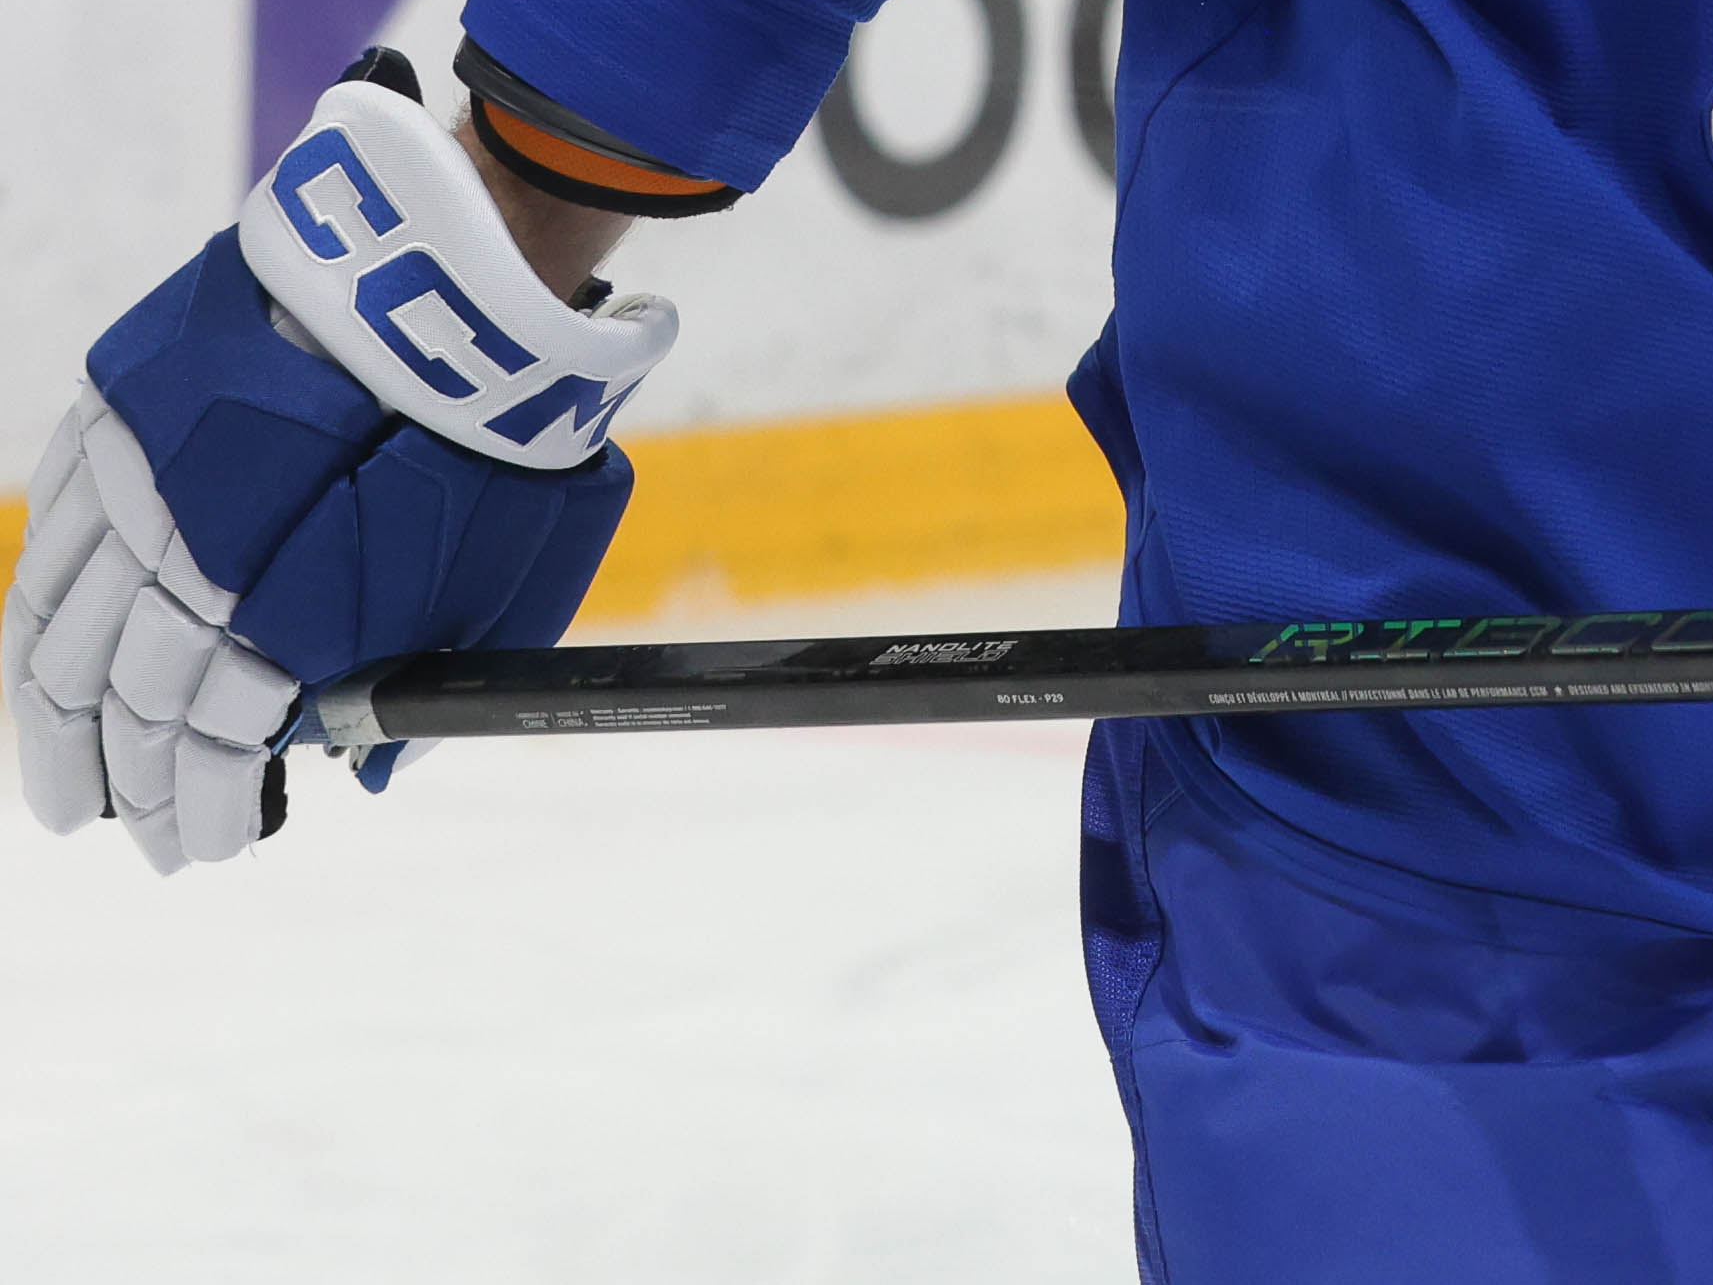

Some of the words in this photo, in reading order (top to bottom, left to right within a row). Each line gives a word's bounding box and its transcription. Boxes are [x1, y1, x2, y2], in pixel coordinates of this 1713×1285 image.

[270, 126, 648, 452] CCM
[886, 639, 1019, 653] NANOLITE
[868, 649, 1009, 666] SHIELD
[1012, 694, 1037, 704] FLEX
[1044, 693, 1065, 704] P29
